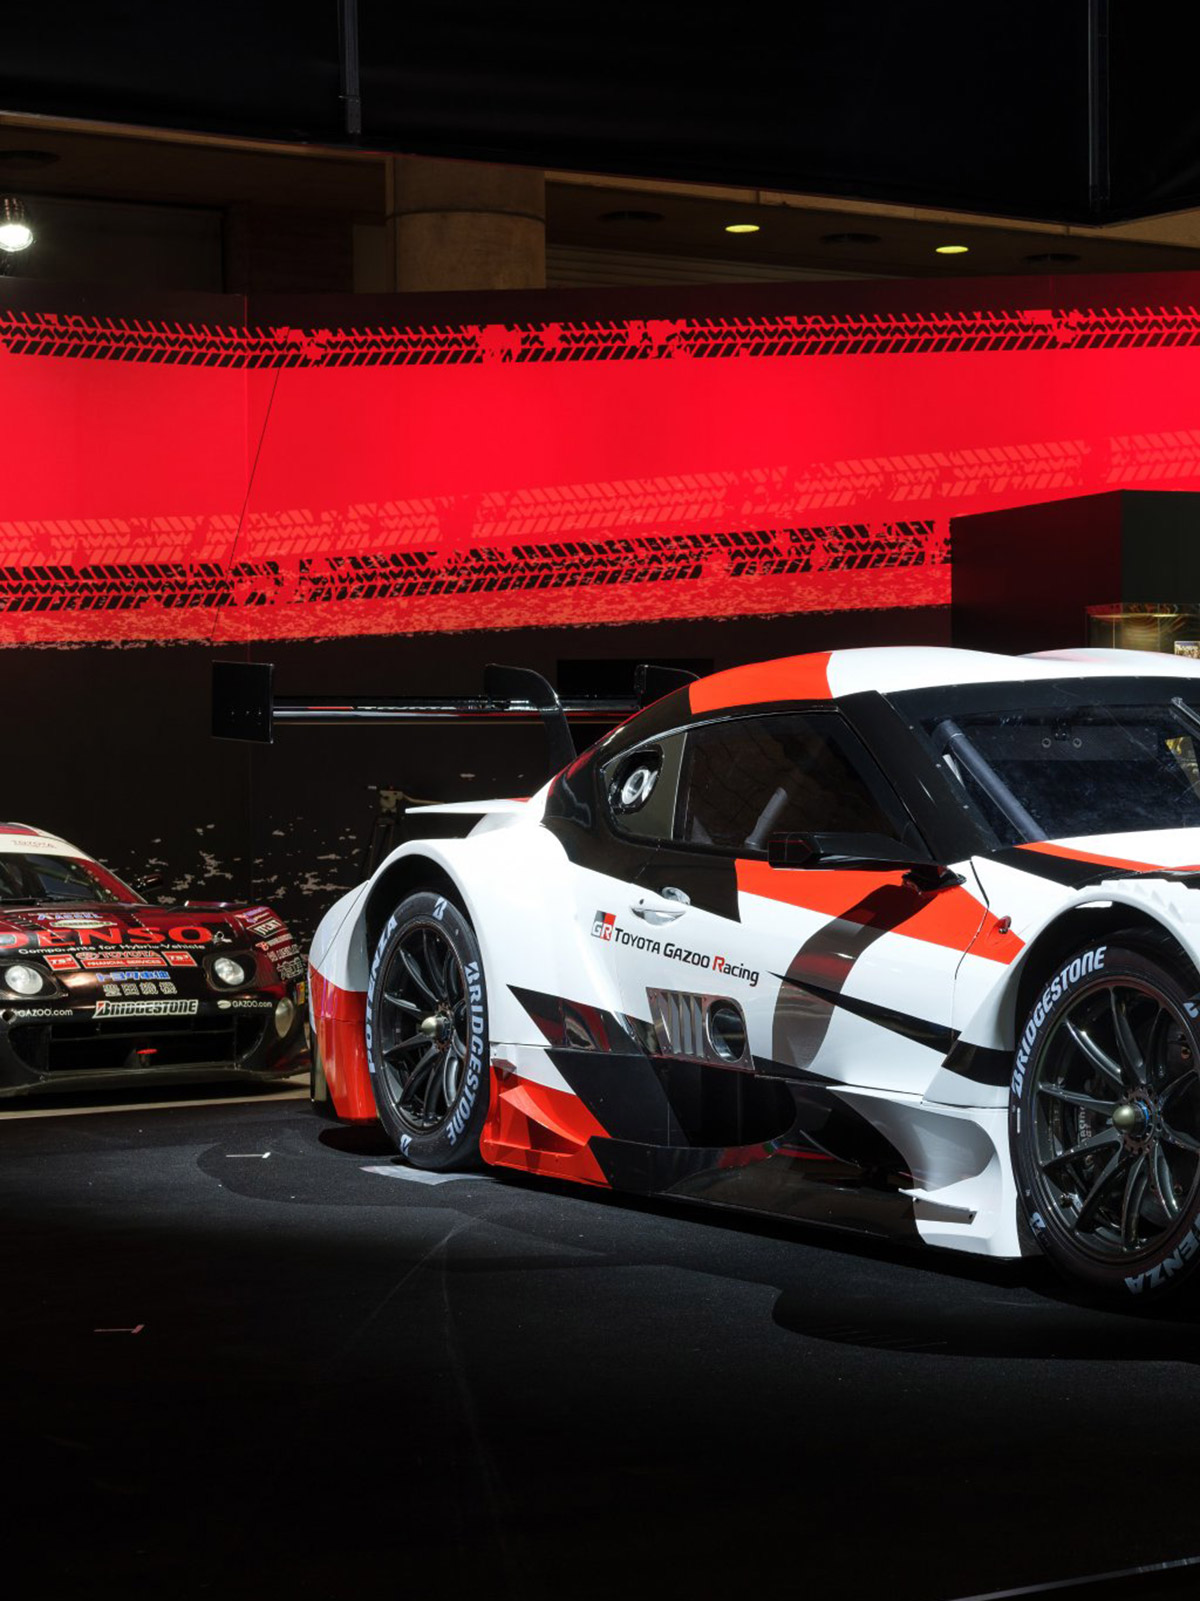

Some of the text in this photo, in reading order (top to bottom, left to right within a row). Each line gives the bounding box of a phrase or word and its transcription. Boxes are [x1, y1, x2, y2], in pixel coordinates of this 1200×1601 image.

[93, 1000, 199, 1018] BRIDGESTONE
[232, 1000, 273, 1008] GAZOO.com
[366, 915, 398, 1074] POTENZA
[614, 928, 661, 955] TOYOTA
[663, 943, 711, 969] GAZOO
[712, 955, 760, 987] Racing
[446, 961, 484, 1146] BRIDGESTONE
[1011, 946, 1108, 1100] BRIDGESTONE
